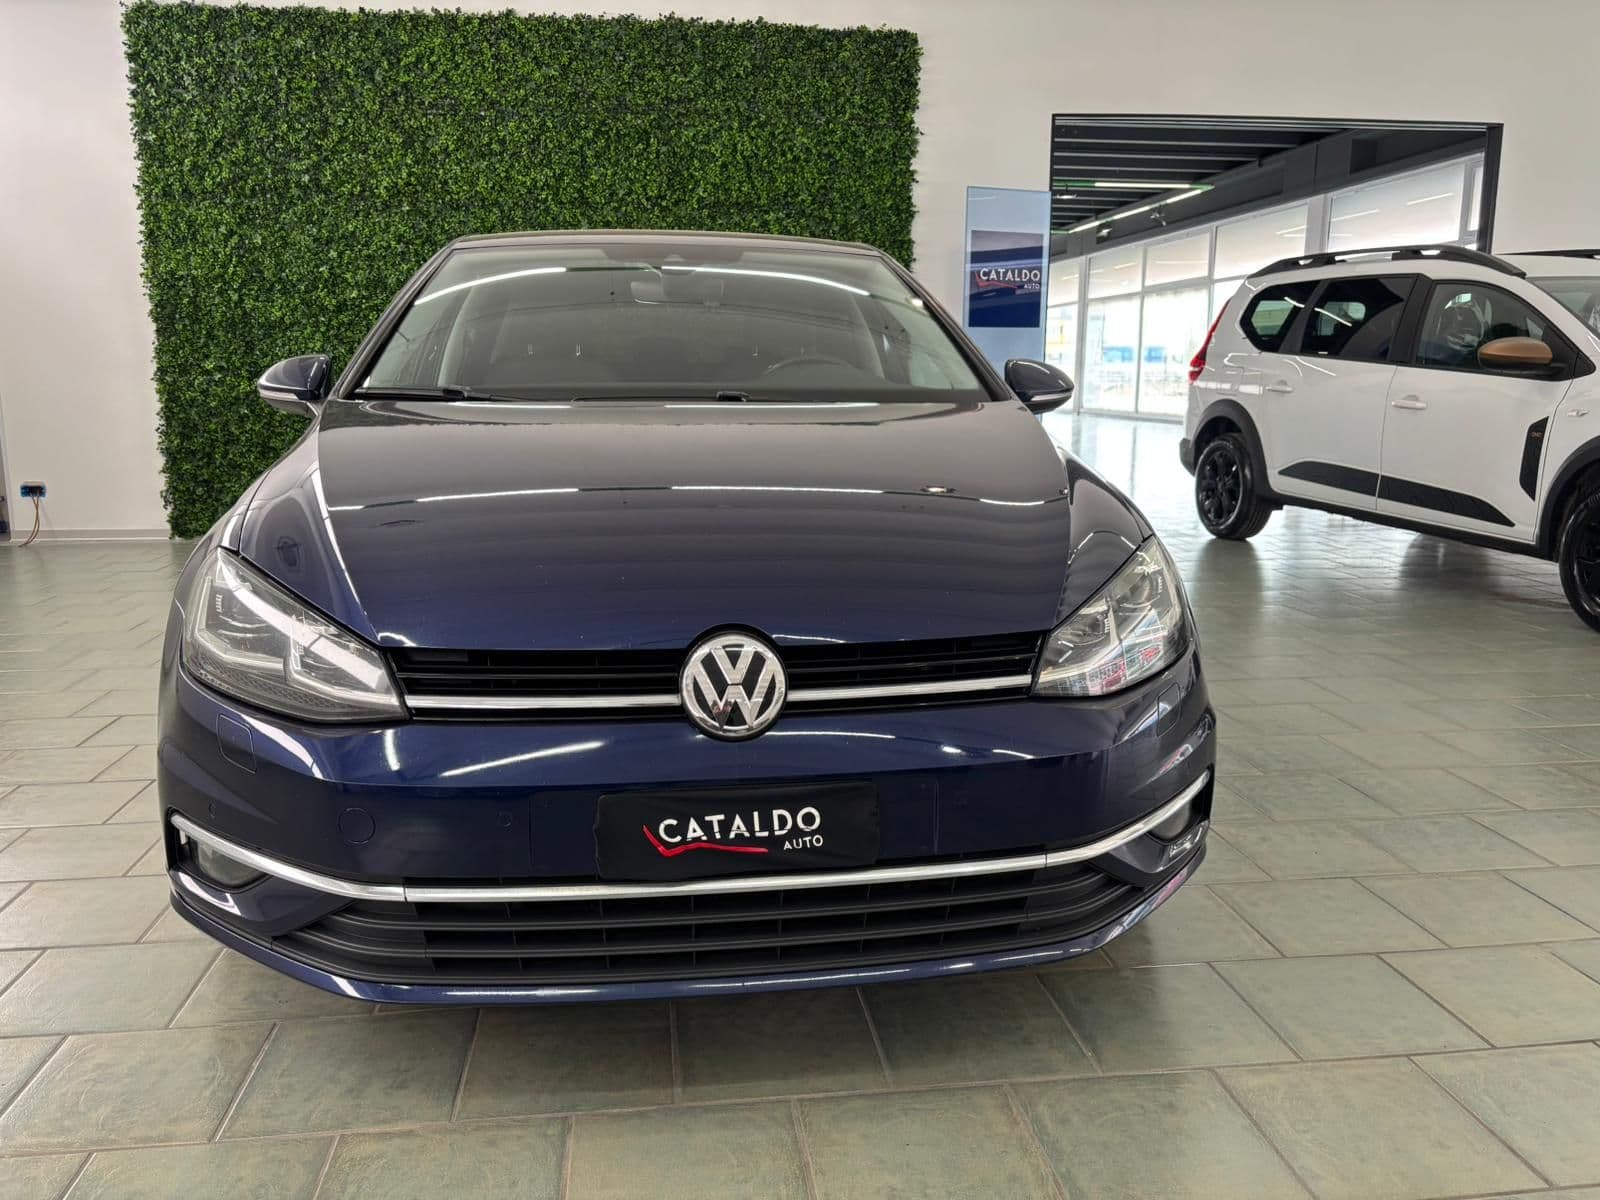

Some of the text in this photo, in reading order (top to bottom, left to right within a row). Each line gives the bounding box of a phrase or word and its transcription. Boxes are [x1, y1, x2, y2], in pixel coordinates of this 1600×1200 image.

[980, 268, 1040, 281] CATALDO
[658, 806, 821, 842] CATALDO
[783, 835, 823, 850] AUTO
